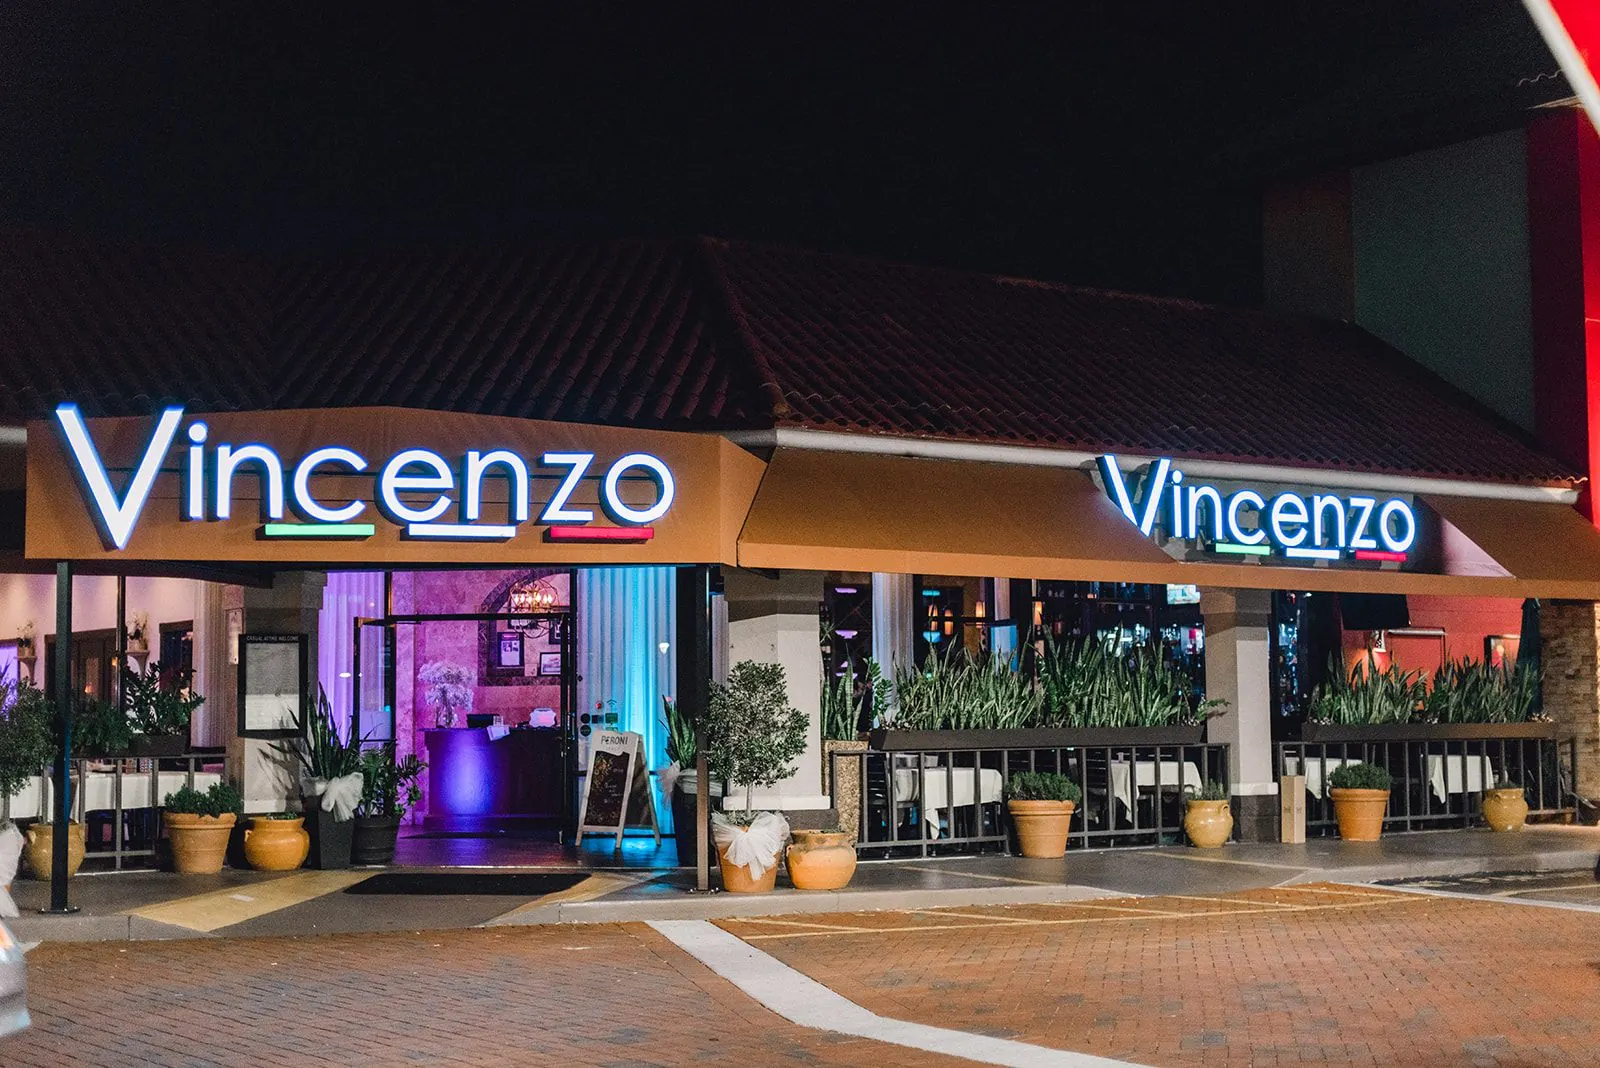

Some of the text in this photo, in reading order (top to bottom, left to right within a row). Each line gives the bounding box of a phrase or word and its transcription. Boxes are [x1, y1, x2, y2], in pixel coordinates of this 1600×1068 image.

[55, 404, 675, 550] Vincenzo
[1096, 453, 1416, 552] Vincenzo
[600, 735, 629, 745] PERONI
